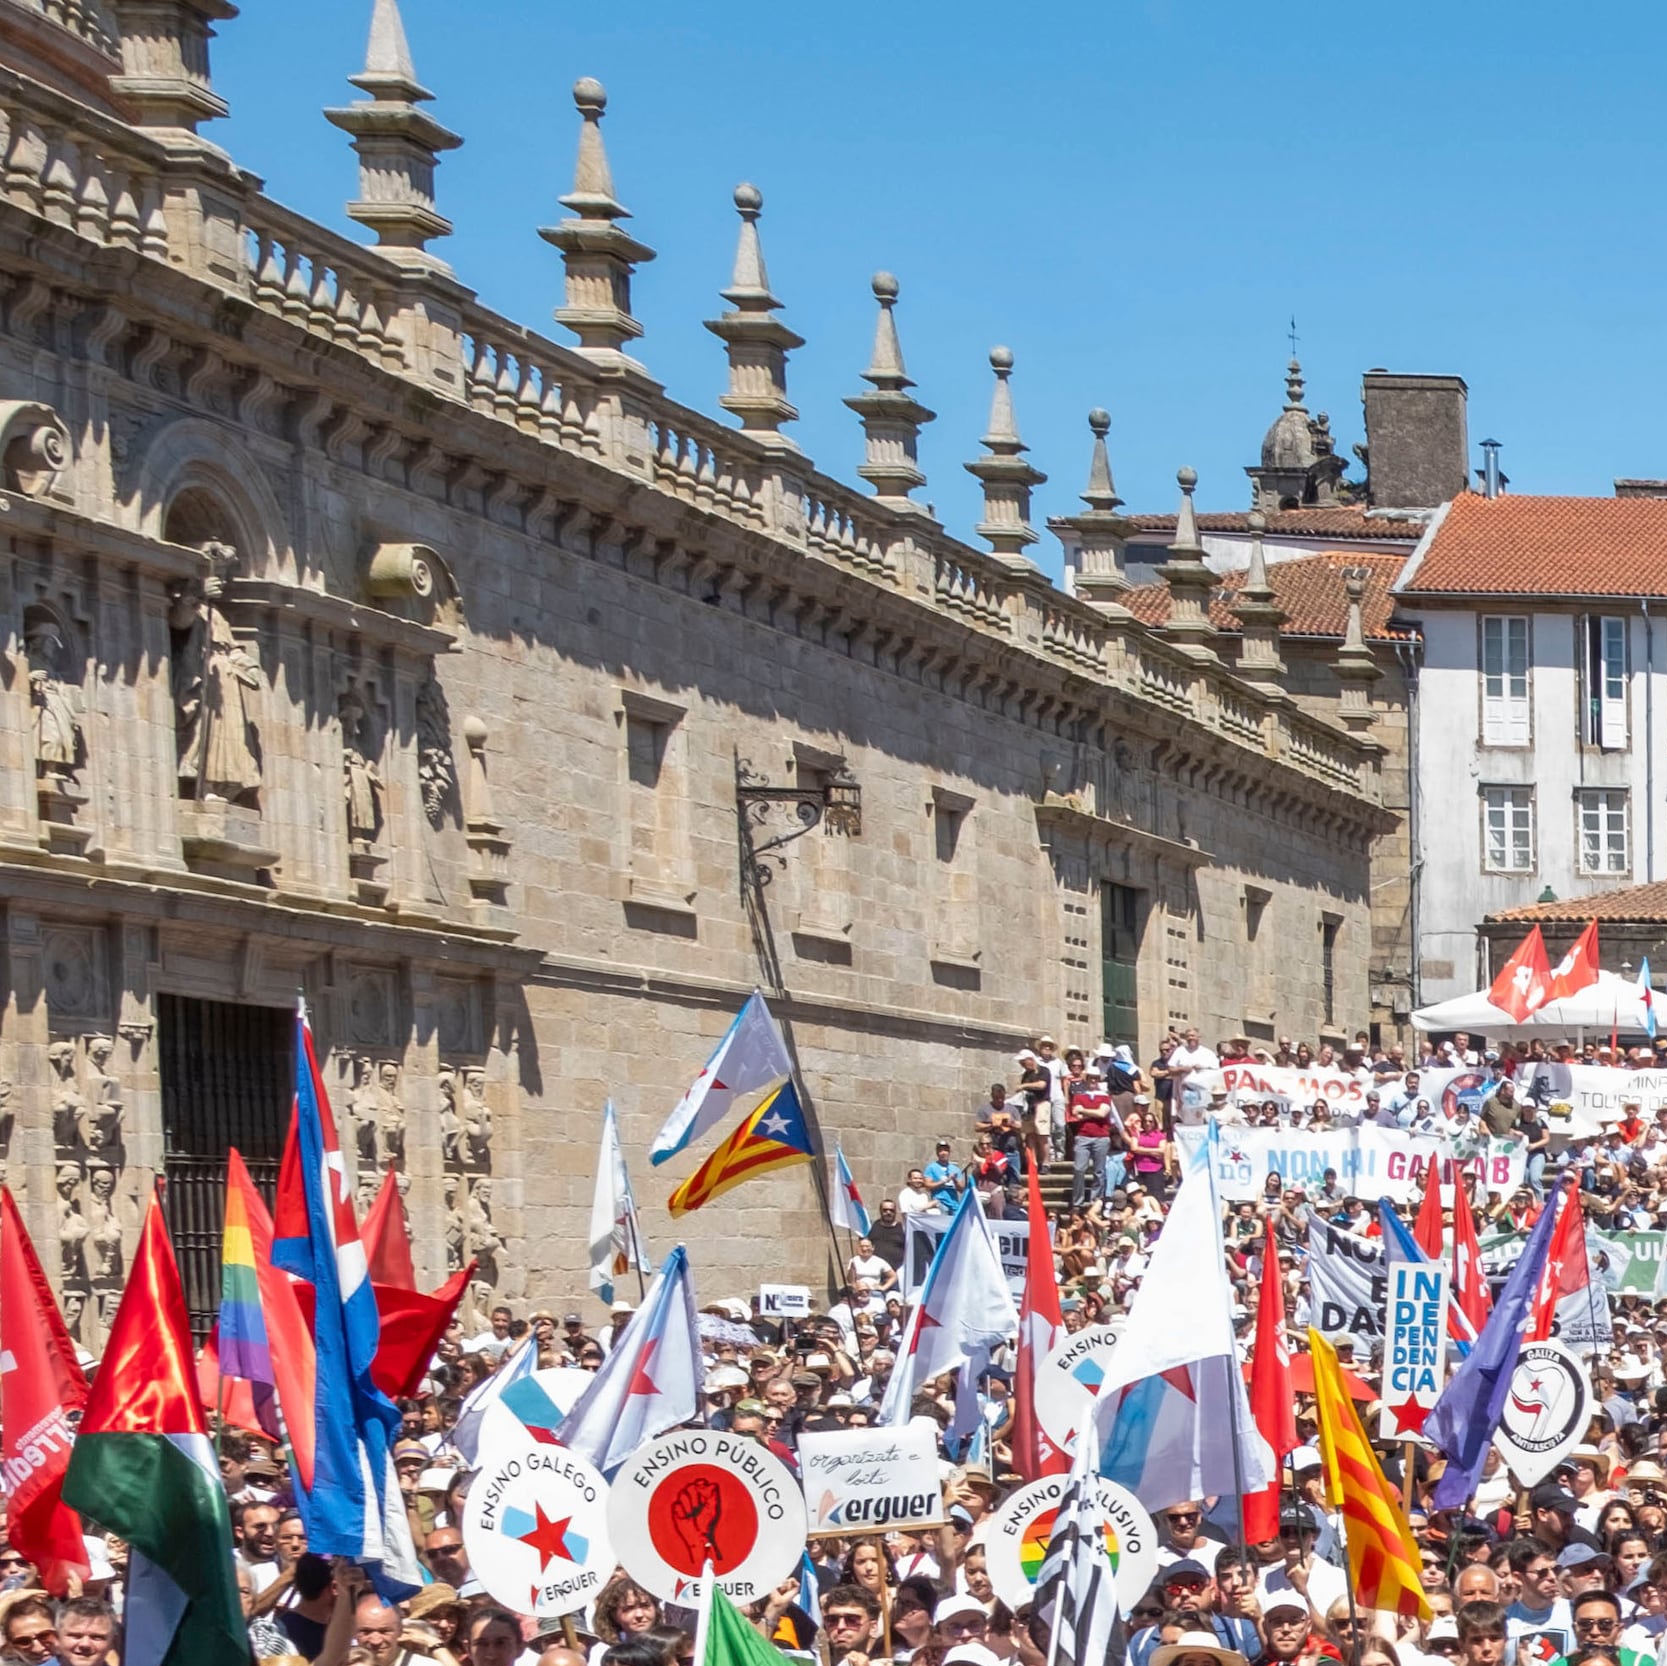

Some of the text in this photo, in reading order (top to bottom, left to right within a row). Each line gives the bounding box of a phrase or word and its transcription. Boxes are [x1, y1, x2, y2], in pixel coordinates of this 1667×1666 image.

[1057, 1332, 1117, 1370] ENSINO
[1527, 1348, 1560, 1364] GALIZA
[480, 1452, 596, 1532] ENSINO GALEGO
[632, 1437, 785, 1521] ENSINO PÚBLICO
[844, 1492, 937, 1524] erguer
[1002, 1484, 1061, 1537] ENSINO
